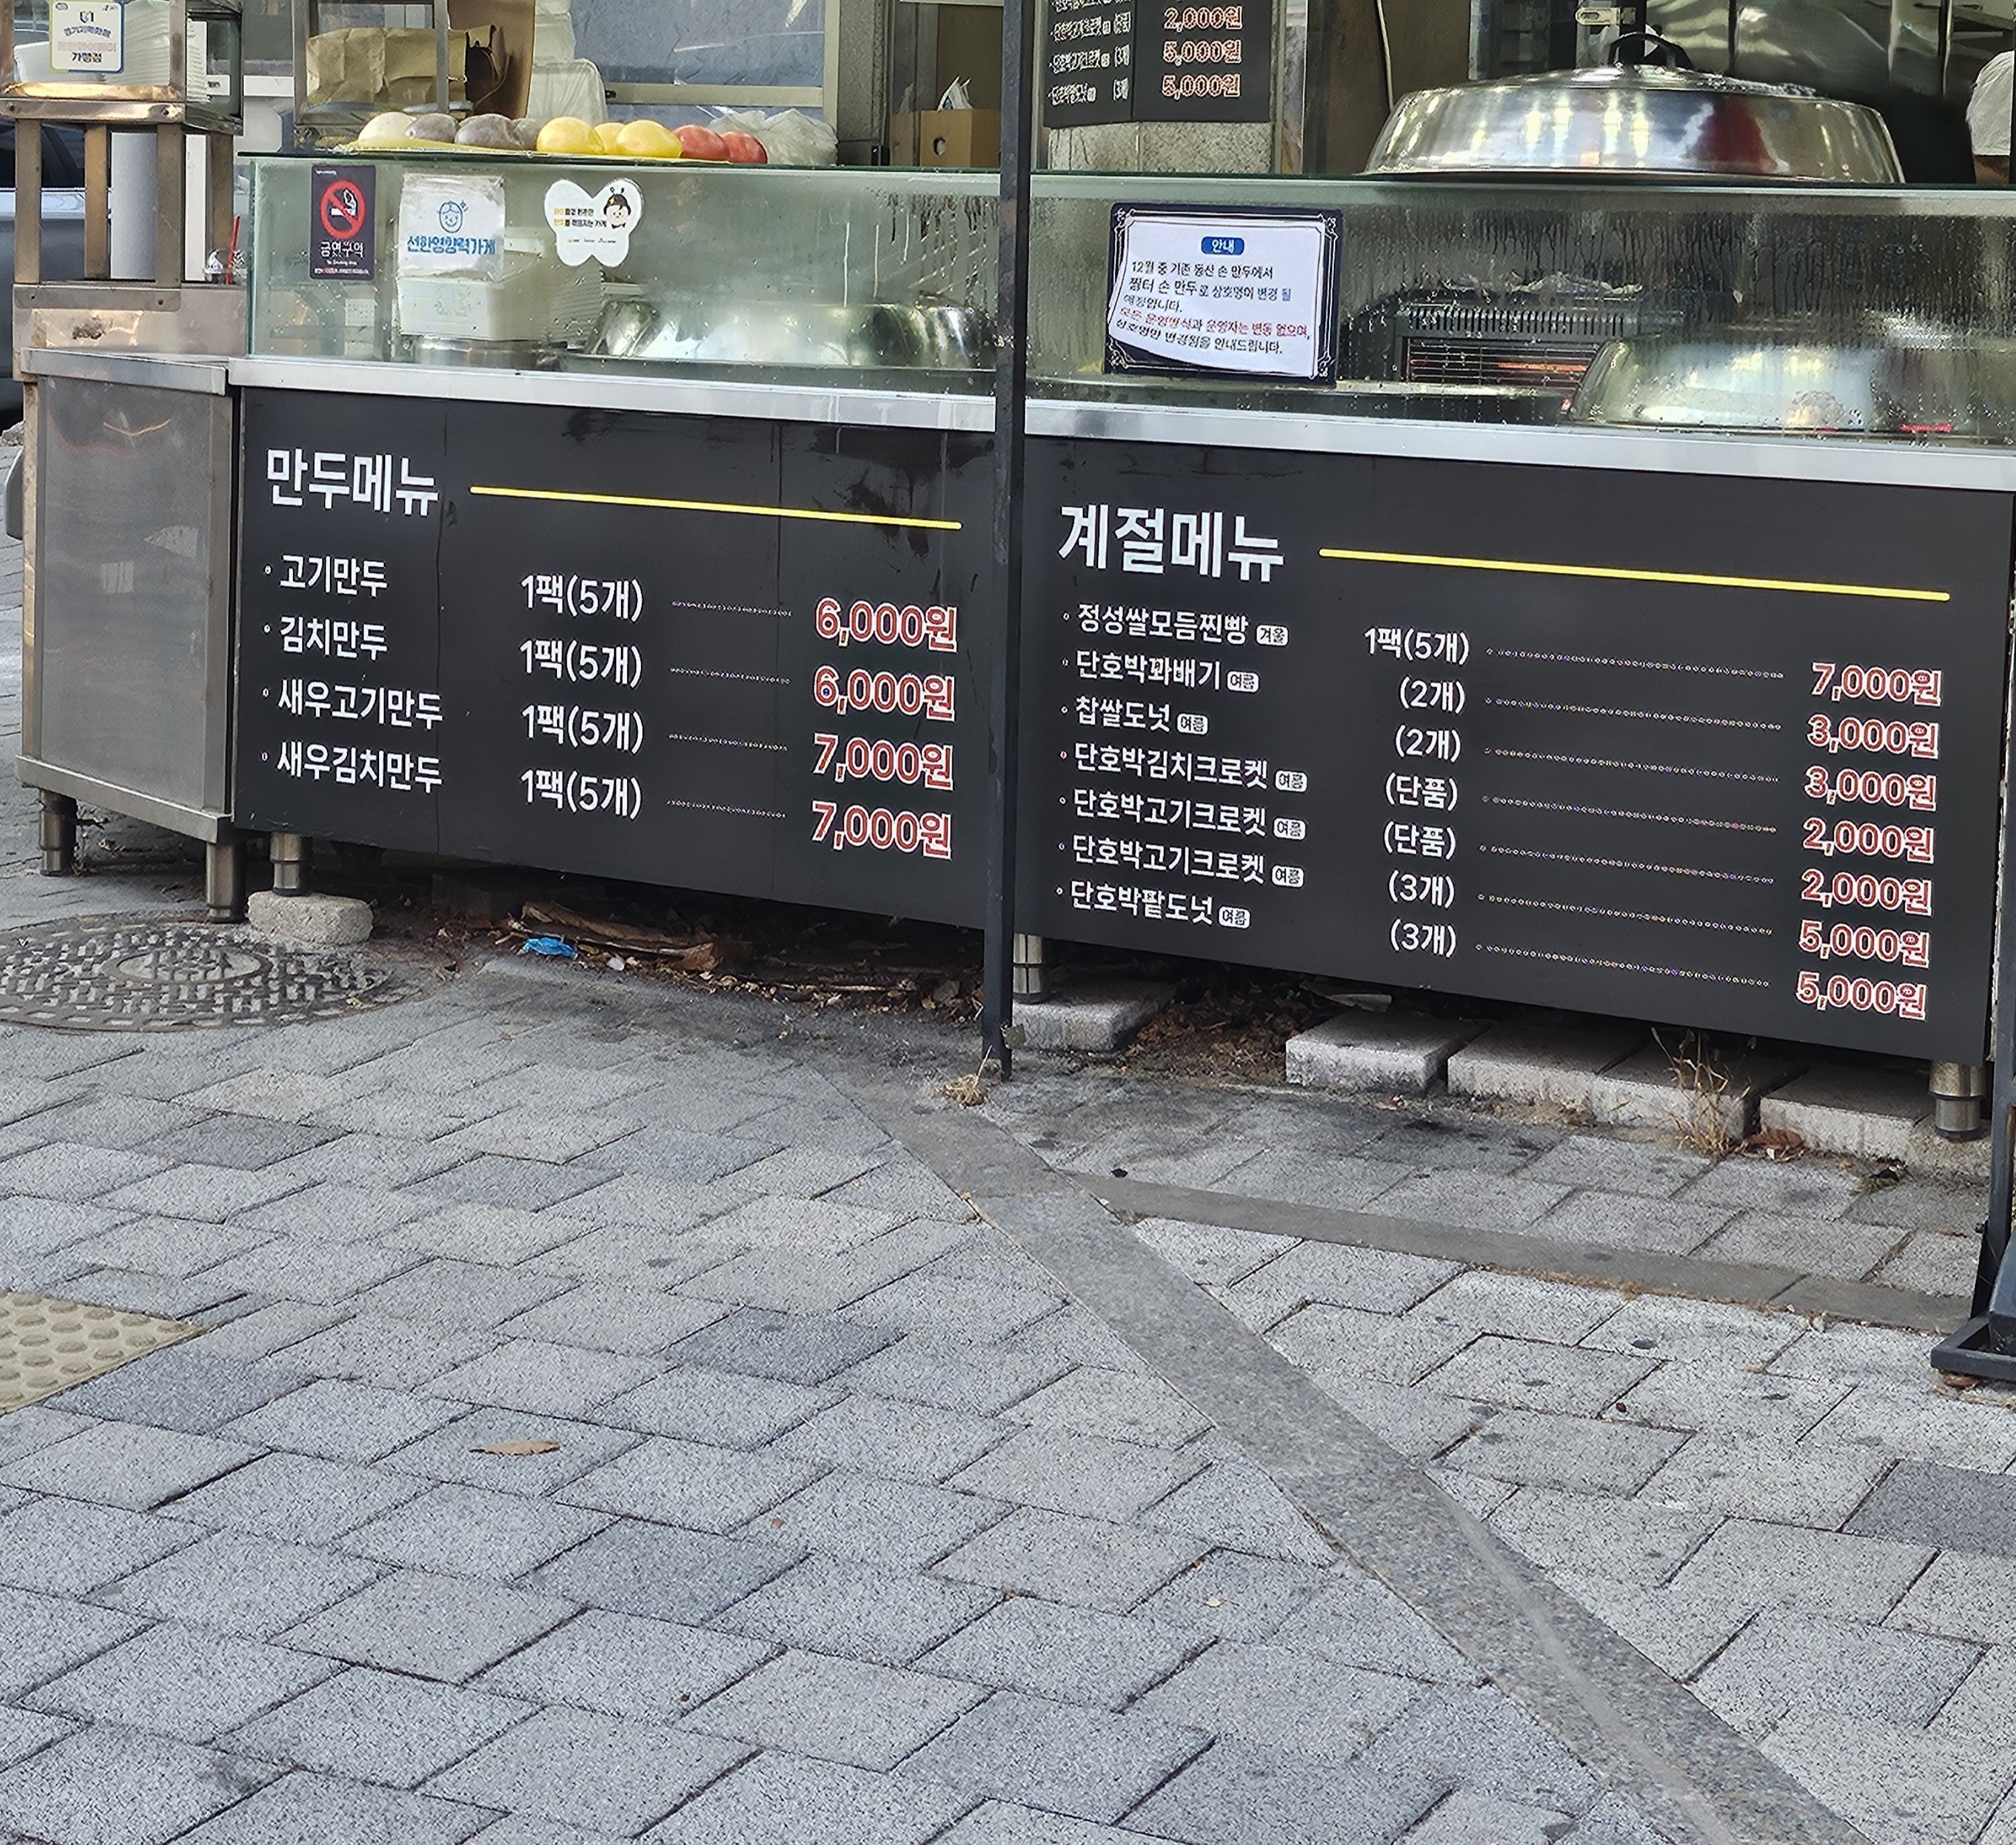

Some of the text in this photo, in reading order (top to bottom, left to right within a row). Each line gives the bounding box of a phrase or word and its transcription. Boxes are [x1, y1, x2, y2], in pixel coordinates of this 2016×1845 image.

[1163, 40, 1241, 66] 5,000원
[1165, 6, 1243, 32] 2,000원
[1162, 74, 1240, 99] 5,000원
[321, 241, 364, 258] 금연구역
[1132, 260, 1154, 274] 12월
[1170, 262, 1191, 276] 기존
[1231, 265, 1273, 280] 만두에서
[1212, 239, 1234, 254] 안내
[1257, 286, 1277, 302] 변경
[1214, 337, 1283, 354] 안내드립니다.
[267, 449, 438, 516] 만두메뉴
[1059, 505, 1284, 581] 계절메뉴
[280, 555, 956, 652] 고기만두 1팩(5개) 6,000원
[281, 617, 955, 721] 김치만두 1팩(5개) 6,000원
[1079, 604, 1249, 644] 정성쌀모듬찐빵
[1365, 628, 1468, 665] 1팩(5개)
[1812, 662, 1941, 706] 7,000원
[278, 680, 953, 790] 새우고기만두 1팩(5개) 7,000원
[1076, 696, 1169, 731] 찹쌀도넛
[1396, 725, 1460, 762] (2개)
[1804, 766, 1936, 811] 3,000원
[1077, 651, 1220, 690] 단호박꽈배기
[1400, 677, 1465, 714] (2개)
[1807, 714, 1939, 759] 3,000원
[278, 741, 951, 860] 새우김치만두 1팩(5개) 7,000원
[1075, 743, 1267, 790] 단호박김치크로켓
[1386, 772, 1457, 811] (단품)
[1804, 817, 1933, 864] 2,000원
[1074, 789, 1265, 837] 단호박고기크로켓
[1384, 821, 1456, 860] (단품)
[1802, 869, 1931, 916] 2,000원
[1073, 835, 1263, 885] 단호박고기크로켓
[1389, 870, 1454, 908] (3개)
[1799, 919, 1929, 968] 5,000원
[1072, 881, 1212, 924] 단호박팥도넛
[1391, 919, 1456, 957] (3개)
[1796, 971, 1927, 1020] 5,000원
